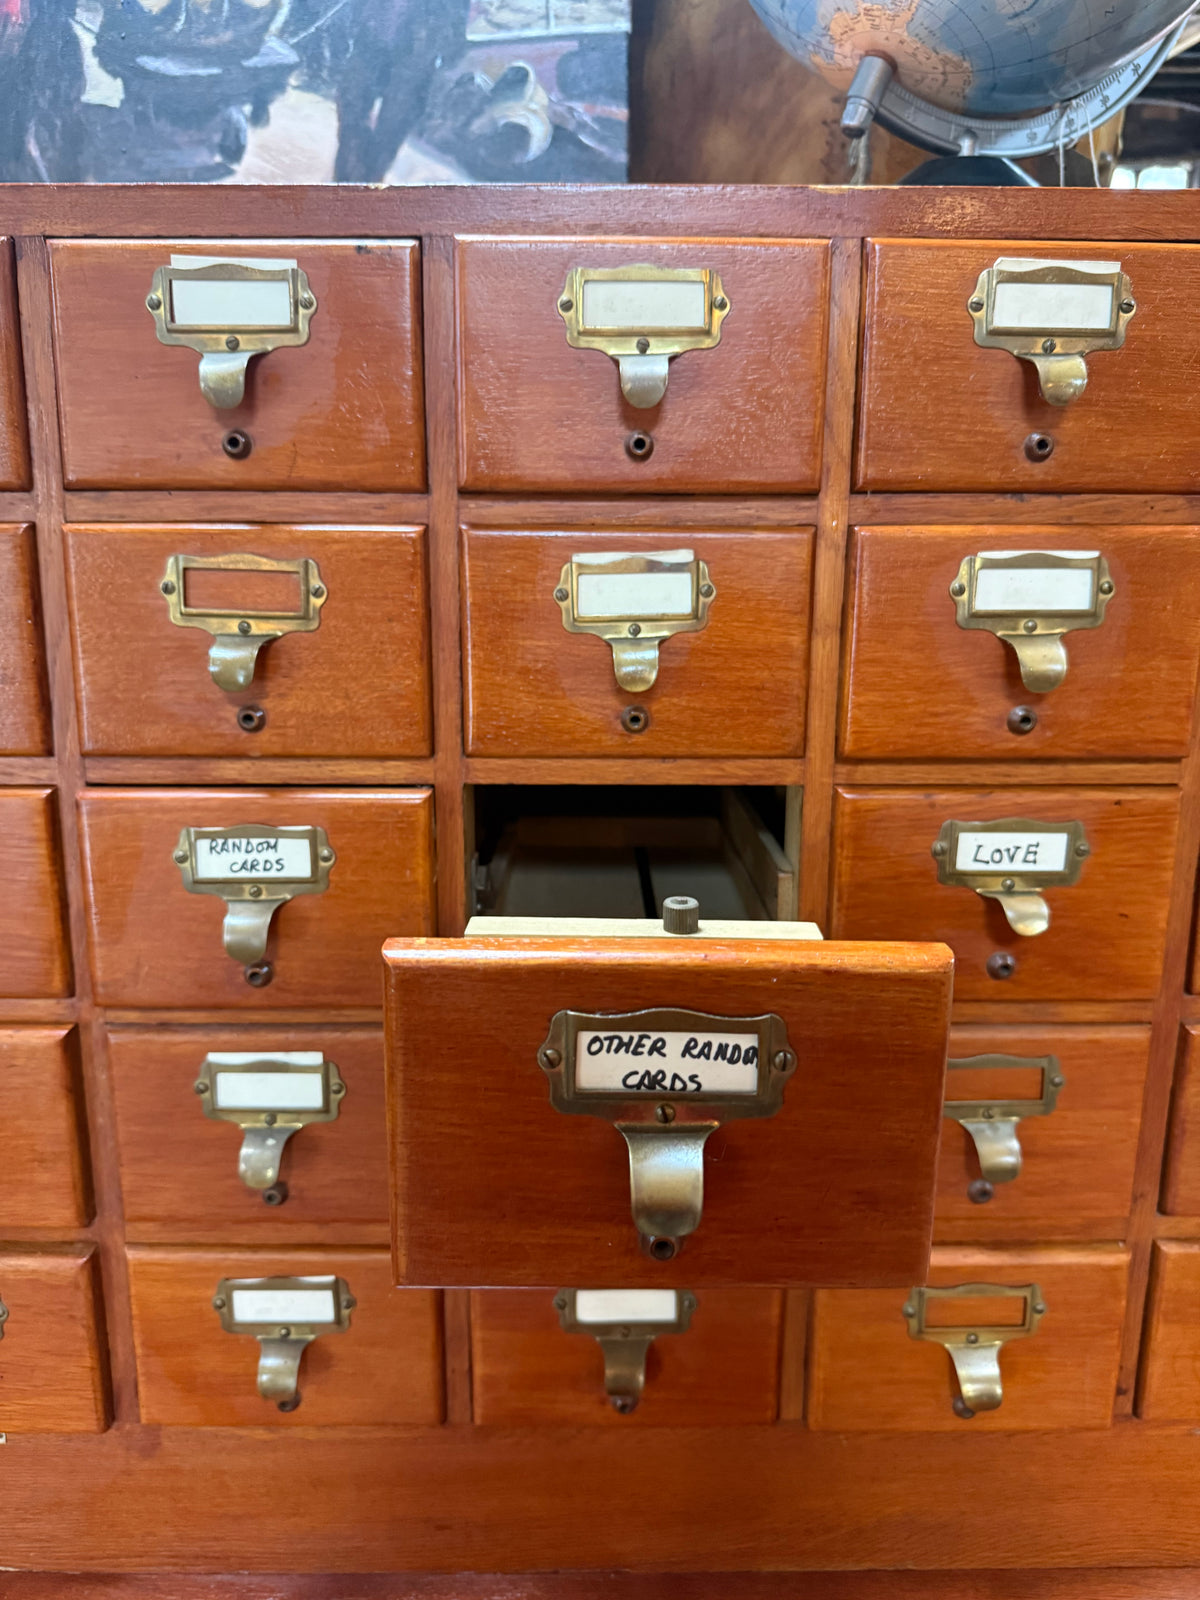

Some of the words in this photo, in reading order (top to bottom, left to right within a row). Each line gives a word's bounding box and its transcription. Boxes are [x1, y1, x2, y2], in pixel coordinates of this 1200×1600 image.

[208, 838, 279, 855] RANDOM
[973, 841, 1040, 865] LOVE
[229, 858, 285, 873] CARDS
[587, 1034, 667, 1058] OTHER
[621, 1069, 702, 1092] CARDS
